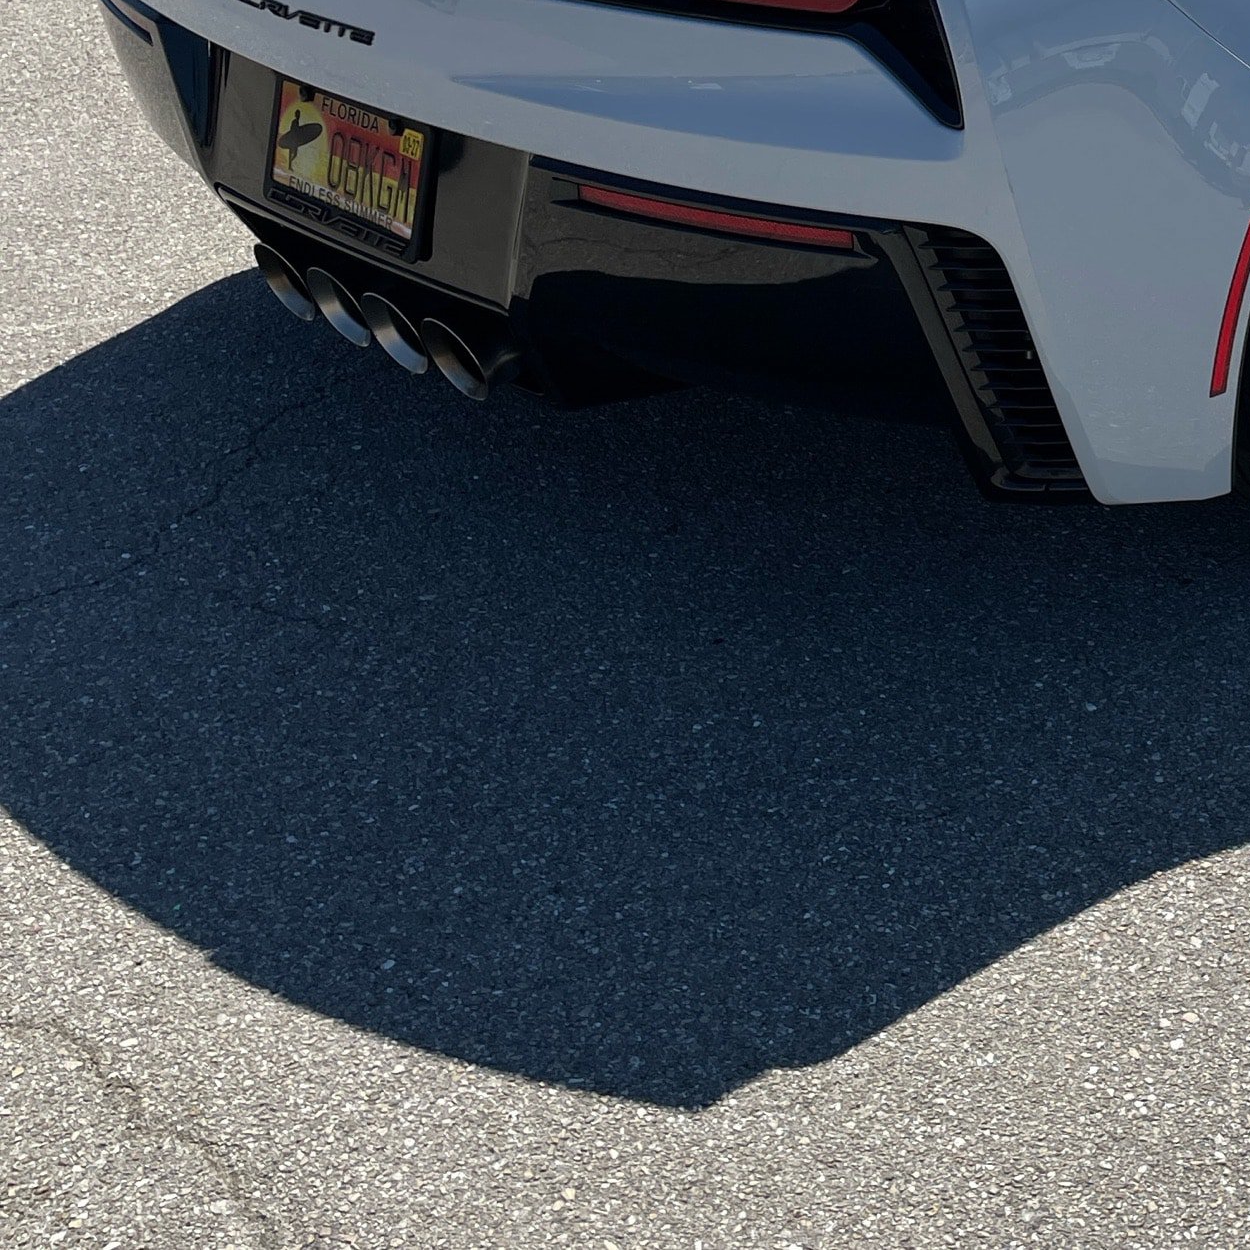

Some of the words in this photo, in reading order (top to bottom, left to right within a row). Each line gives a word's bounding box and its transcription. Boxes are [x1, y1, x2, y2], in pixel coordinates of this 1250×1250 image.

[321, 97, 380, 133] FLORIDA
[267, 187, 407, 257] CORVETTE
[288, 175, 341, 209] ENDLESS
[344, 198, 394, 232] SUMMER
